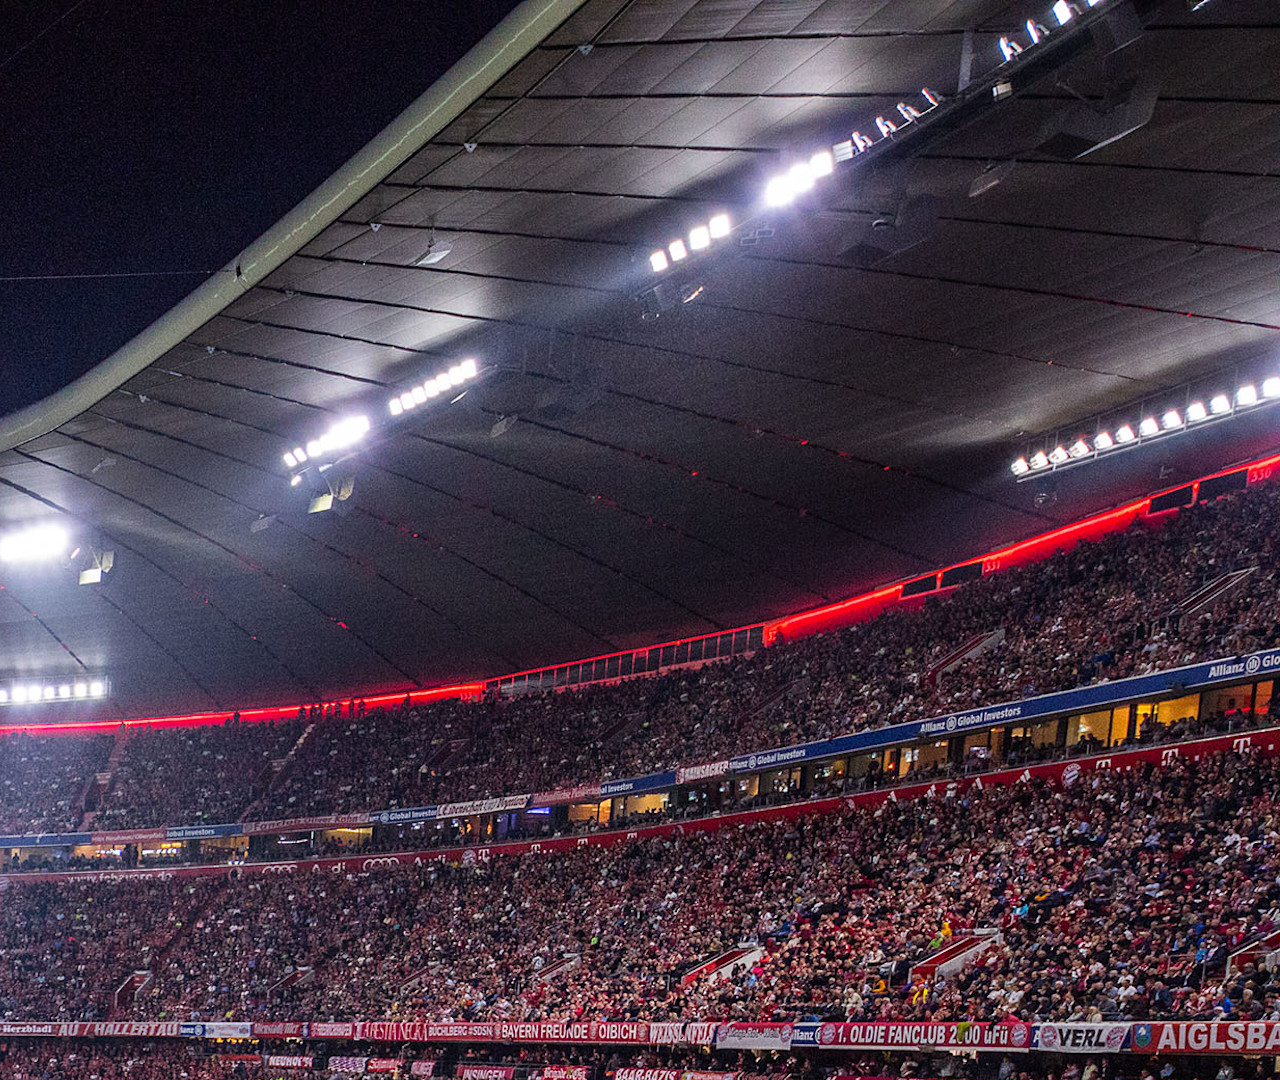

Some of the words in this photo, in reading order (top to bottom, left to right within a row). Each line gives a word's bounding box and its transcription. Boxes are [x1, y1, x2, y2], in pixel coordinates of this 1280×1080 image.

[1209, 661, 1244, 678] Allianz
[920, 719, 945, 733] Allianz
[957, 711, 987, 727] Global
[987, 706, 1022, 722] Investors
[757, 753, 782, 766] Global
[783, 748, 806, 761] Investors
[607, 782, 633, 793] Investors
[94, 1023, 177, 1035] HALLERTAU
[502, 1024, 539, 1038] BAYERN
[541, 1024, 587, 1038] FREUNDE
[598, 1024, 637, 1039] OIBICH
[850, 1025, 887, 1044] OLDIE
[889, 1025, 944, 1044] FANCLUB
[1058, 1028, 1106, 1048] VERL
